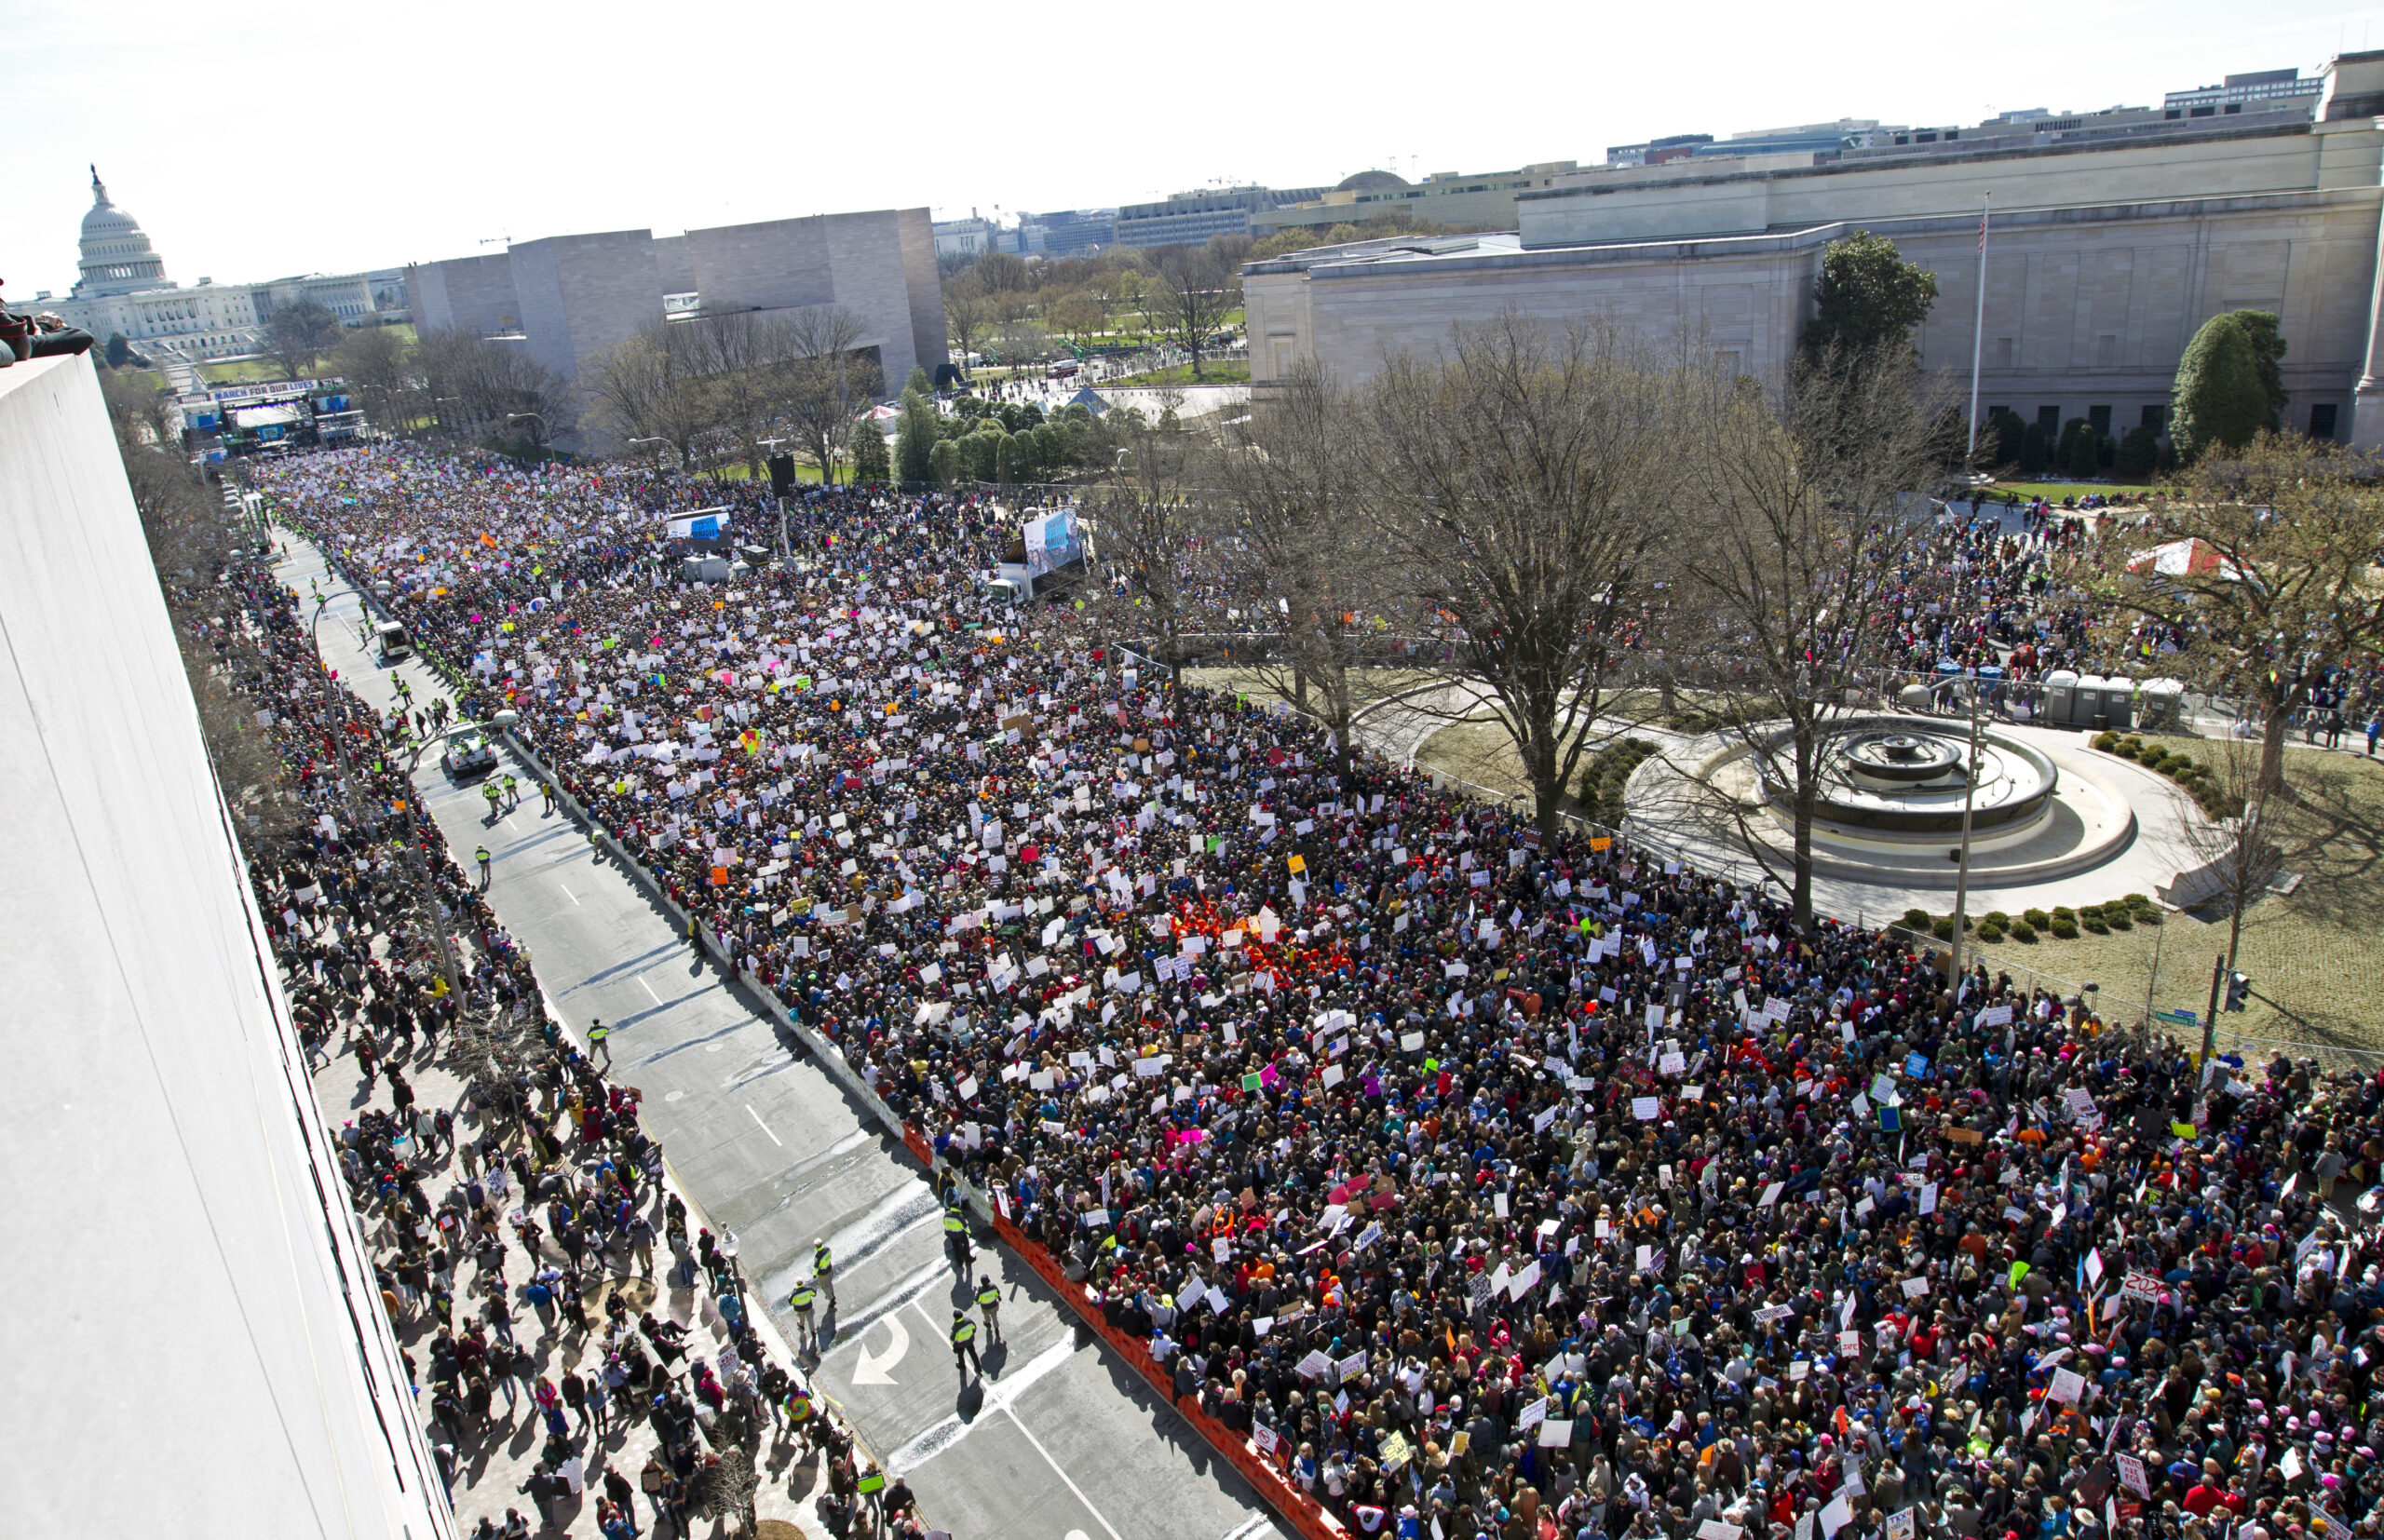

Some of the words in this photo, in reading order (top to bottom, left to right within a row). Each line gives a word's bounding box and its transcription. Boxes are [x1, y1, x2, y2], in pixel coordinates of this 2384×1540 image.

[214, 388, 247, 400] MARCH
[250, 386, 268, 396] FOR
[269, 384, 289, 393] OUR
[289, 380, 314, 390] LIVES
[692, 518, 715, 527] ENOUGH
[1482, 820, 1495, 830] 2018
[1524, 841, 1539, 850] 2018
[2157, 1012, 2188, 1024] Pennsylvania
[1388, 1429, 1405, 1452] VOTE
[1383, 1444, 1399, 1463] OUT
[2120, 1455, 2143, 1469] ARMS
[2124, 1467, 2138, 1478] ARE
[2124, 1474, 2141, 1485] FOR
